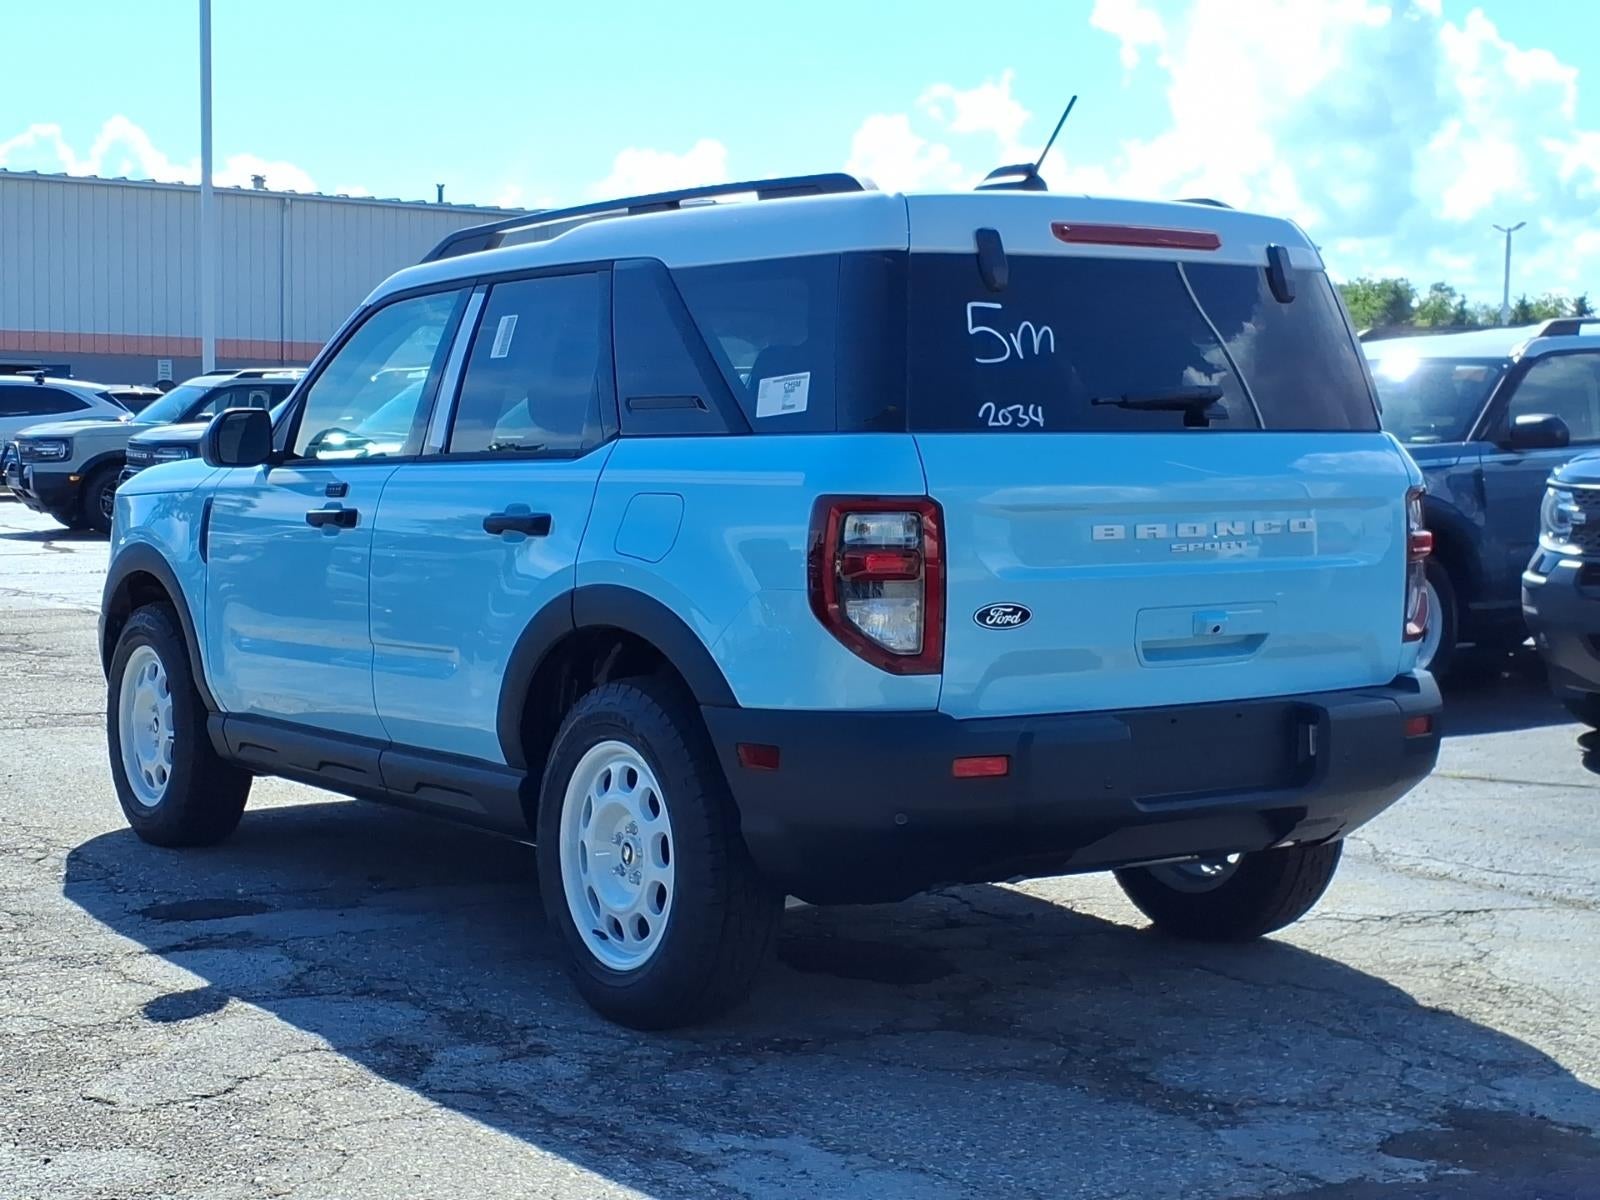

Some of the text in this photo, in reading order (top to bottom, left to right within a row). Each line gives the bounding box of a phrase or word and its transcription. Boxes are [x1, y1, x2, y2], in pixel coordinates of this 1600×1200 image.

[978, 402, 1044, 427] 2034
[1092, 518, 1314, 541] BRONCO
[1170, 541, 1248, 553] SPORT
[985, 607, 1022, 625] Ford
